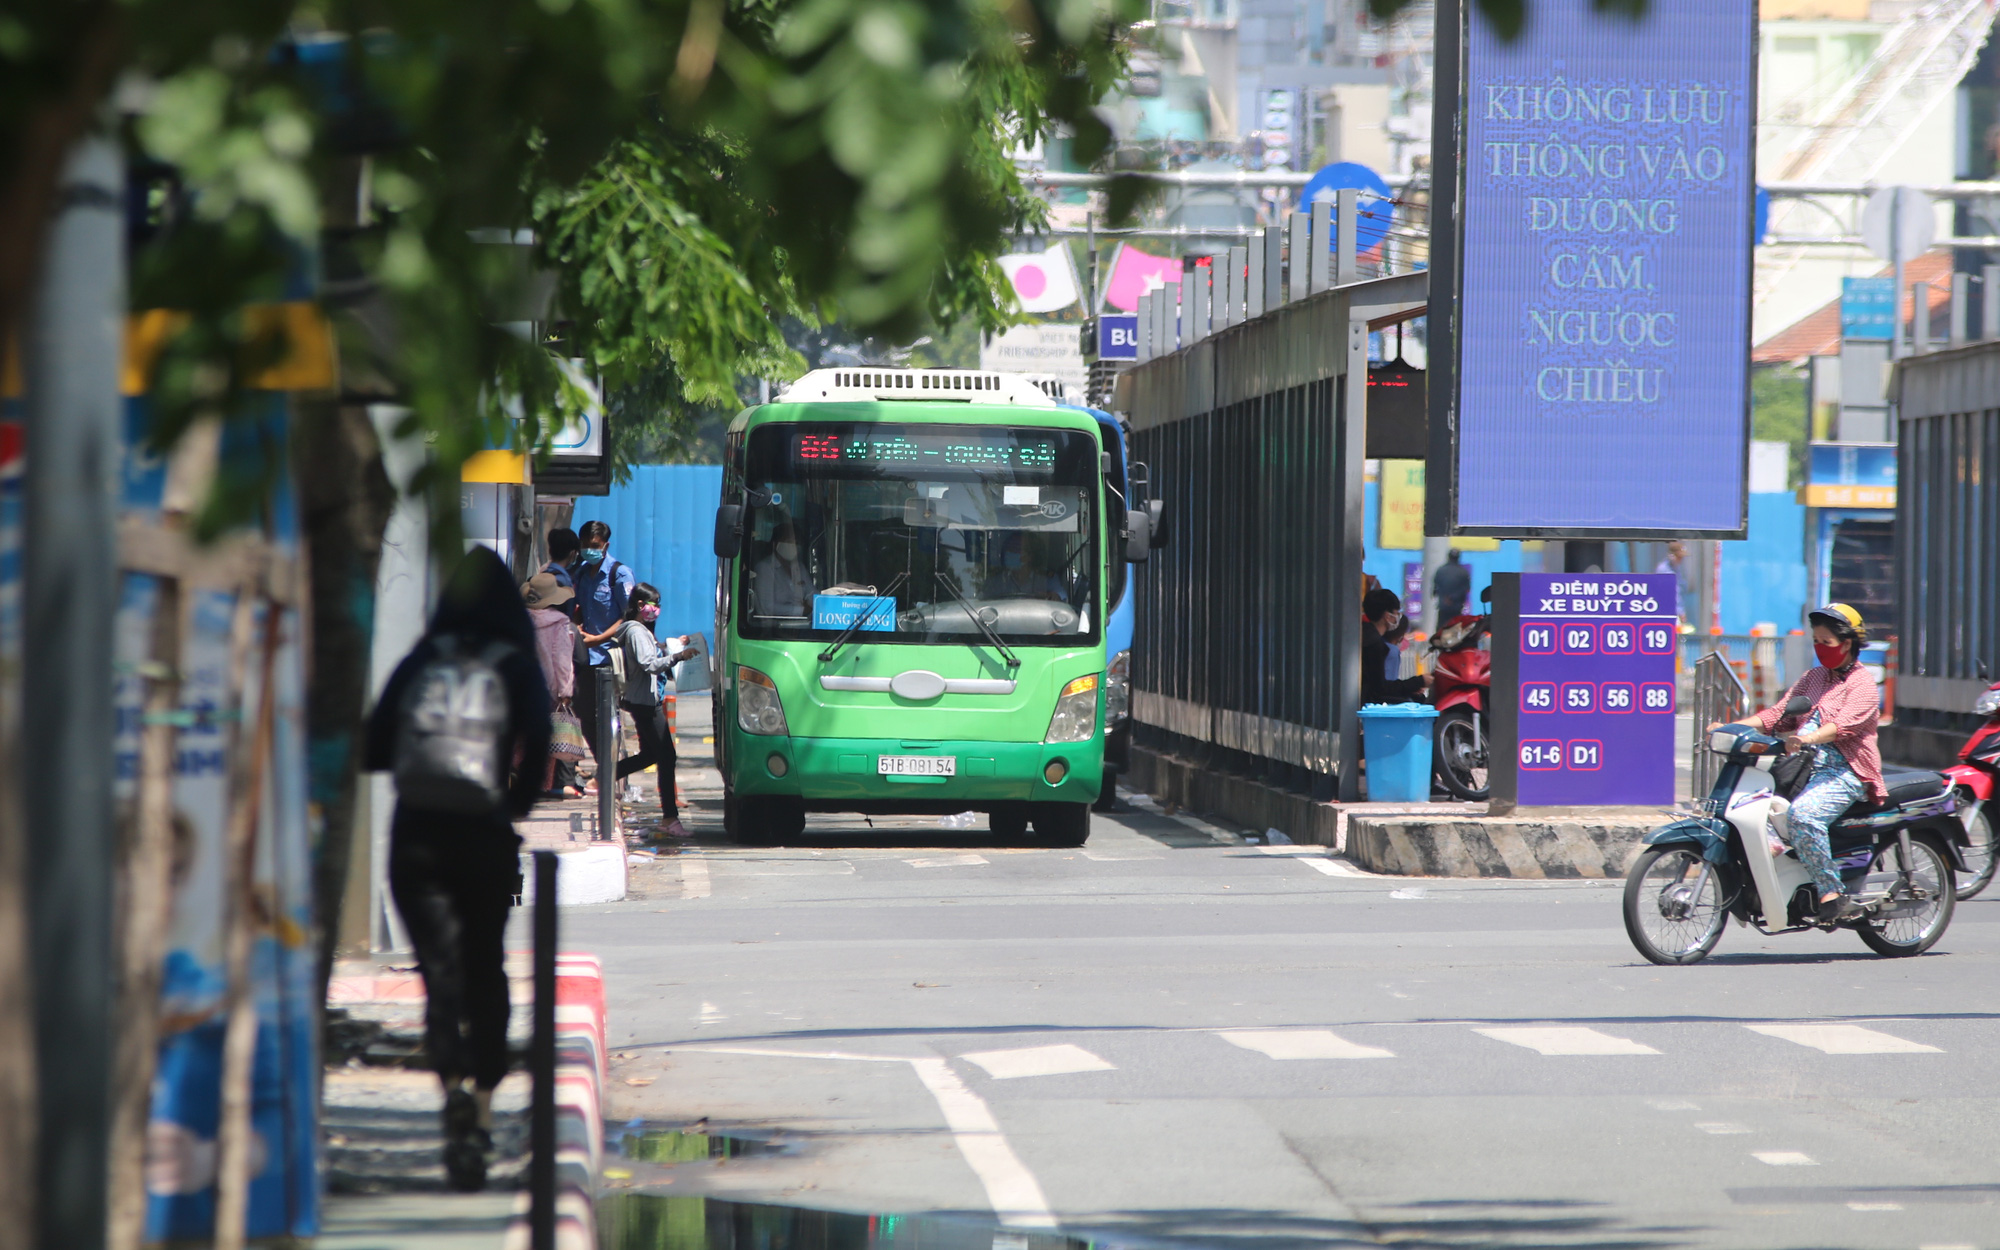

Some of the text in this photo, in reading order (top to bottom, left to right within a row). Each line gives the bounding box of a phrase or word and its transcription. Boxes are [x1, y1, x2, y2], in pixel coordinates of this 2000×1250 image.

[1483, 76, 1729, 125] KHÔNG LƯU
[1484, 132, 1726, 181] THÔNG VÀO
[1528, 186, 1679, 233] ĐƯỜNG
[1527, 304, 1675, 353] NGƯỢC
[1537, 358, 1665, 403] CHIỀU
[1603, 580, 1648, 596] ĐÓN
[1540, 599, 1567, 612] XE
[1572, 596, 1625, 612] BUÝT
[819, 612, 850, 625] LONG
[1528, 630, 1667, 648] 01 02 03 19
[1527, 689, 1668, 707] 45 53 56 88
[1521, 746, 1598, 764] 61-6 D1
